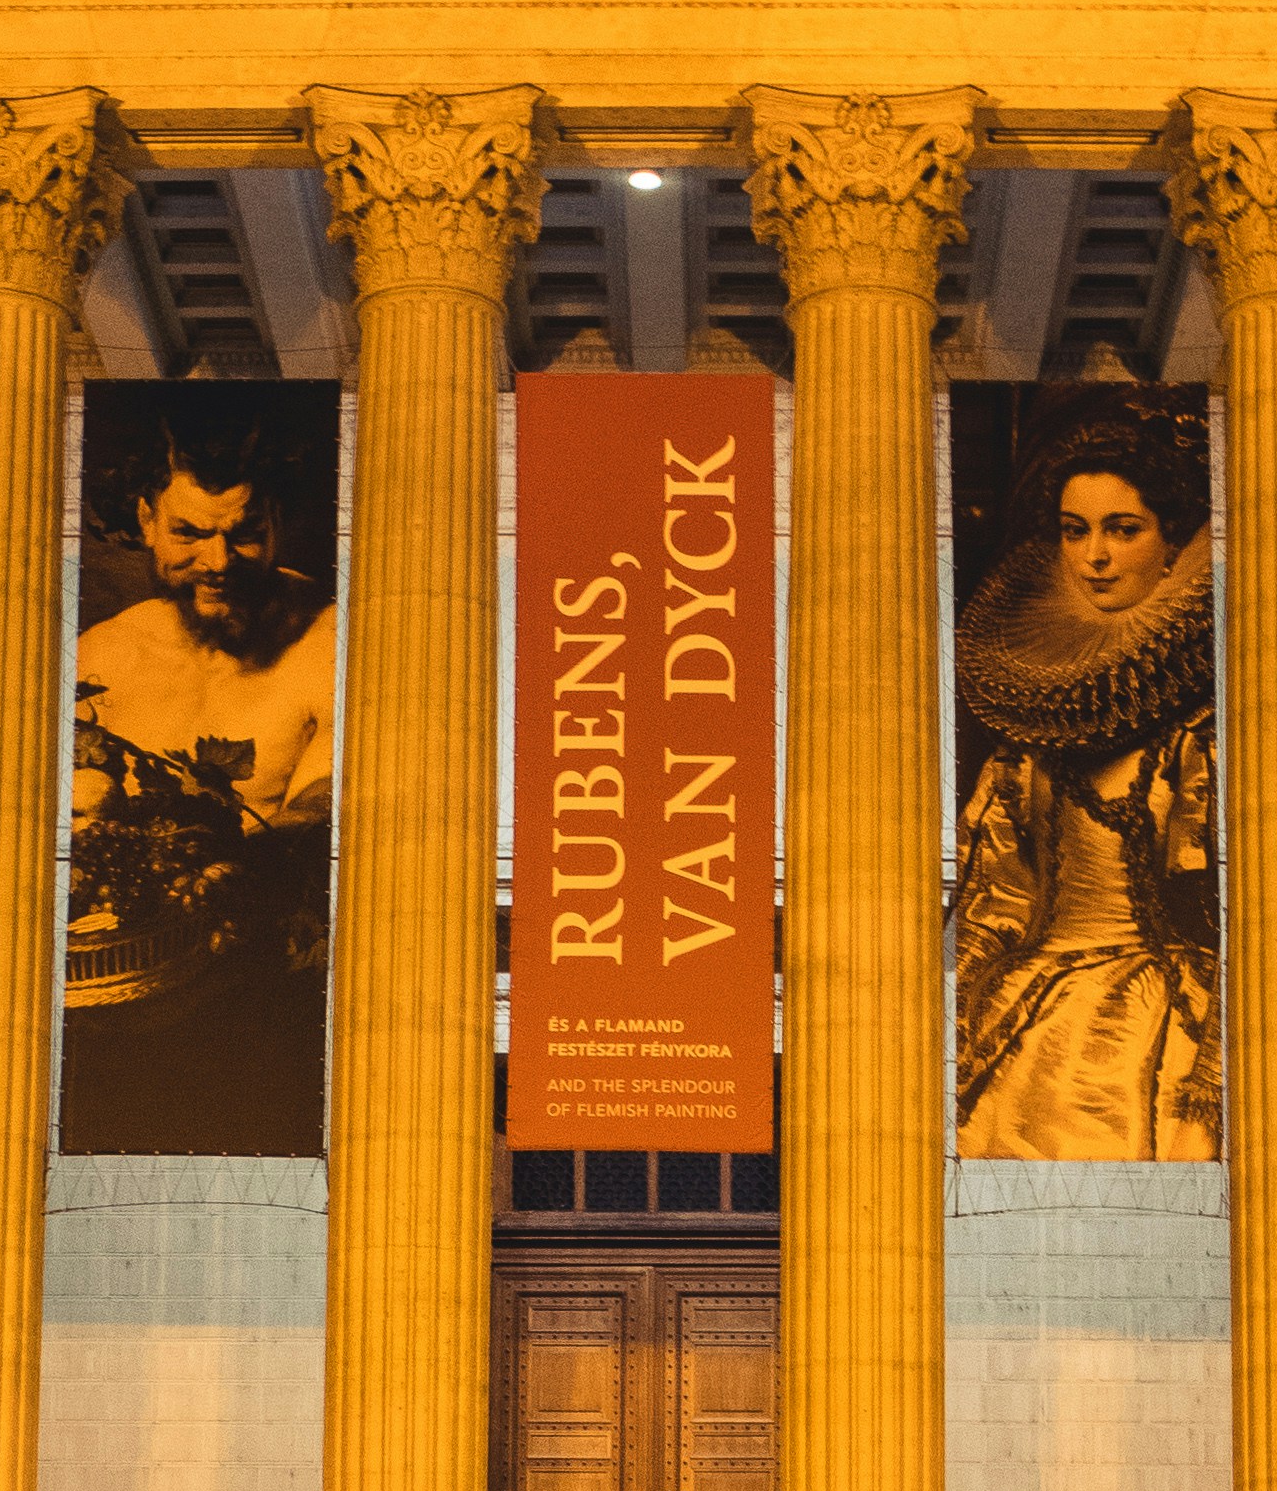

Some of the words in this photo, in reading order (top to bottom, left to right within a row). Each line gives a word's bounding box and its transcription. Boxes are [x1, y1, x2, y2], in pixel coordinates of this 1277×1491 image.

[662, 434, 737, 703] DYCK
[551, 552, 642, 965] RUBENS,
[662, 747, 736, 967] VAN
[548, 1016, 569, 1032] ÉS
[575, 1019, 589, 1032] A
[595, 1019, 684, 1033] FLAMAND
[548, 1041, 636, 1057] FESTÉSZET
[641, 1041, 732, 1058] FÉNYKORA
[547, 1079, 586, 1093] AND
[592, 1079, 624, 1093] THE
[631, 1080, 735, 1094] SPLENDOUR
[547, 1104, 570, 1118] OF
[577, 1104, 648, 1118] FLEMISH
[655, 1105, 736, 1119] PAINTING
